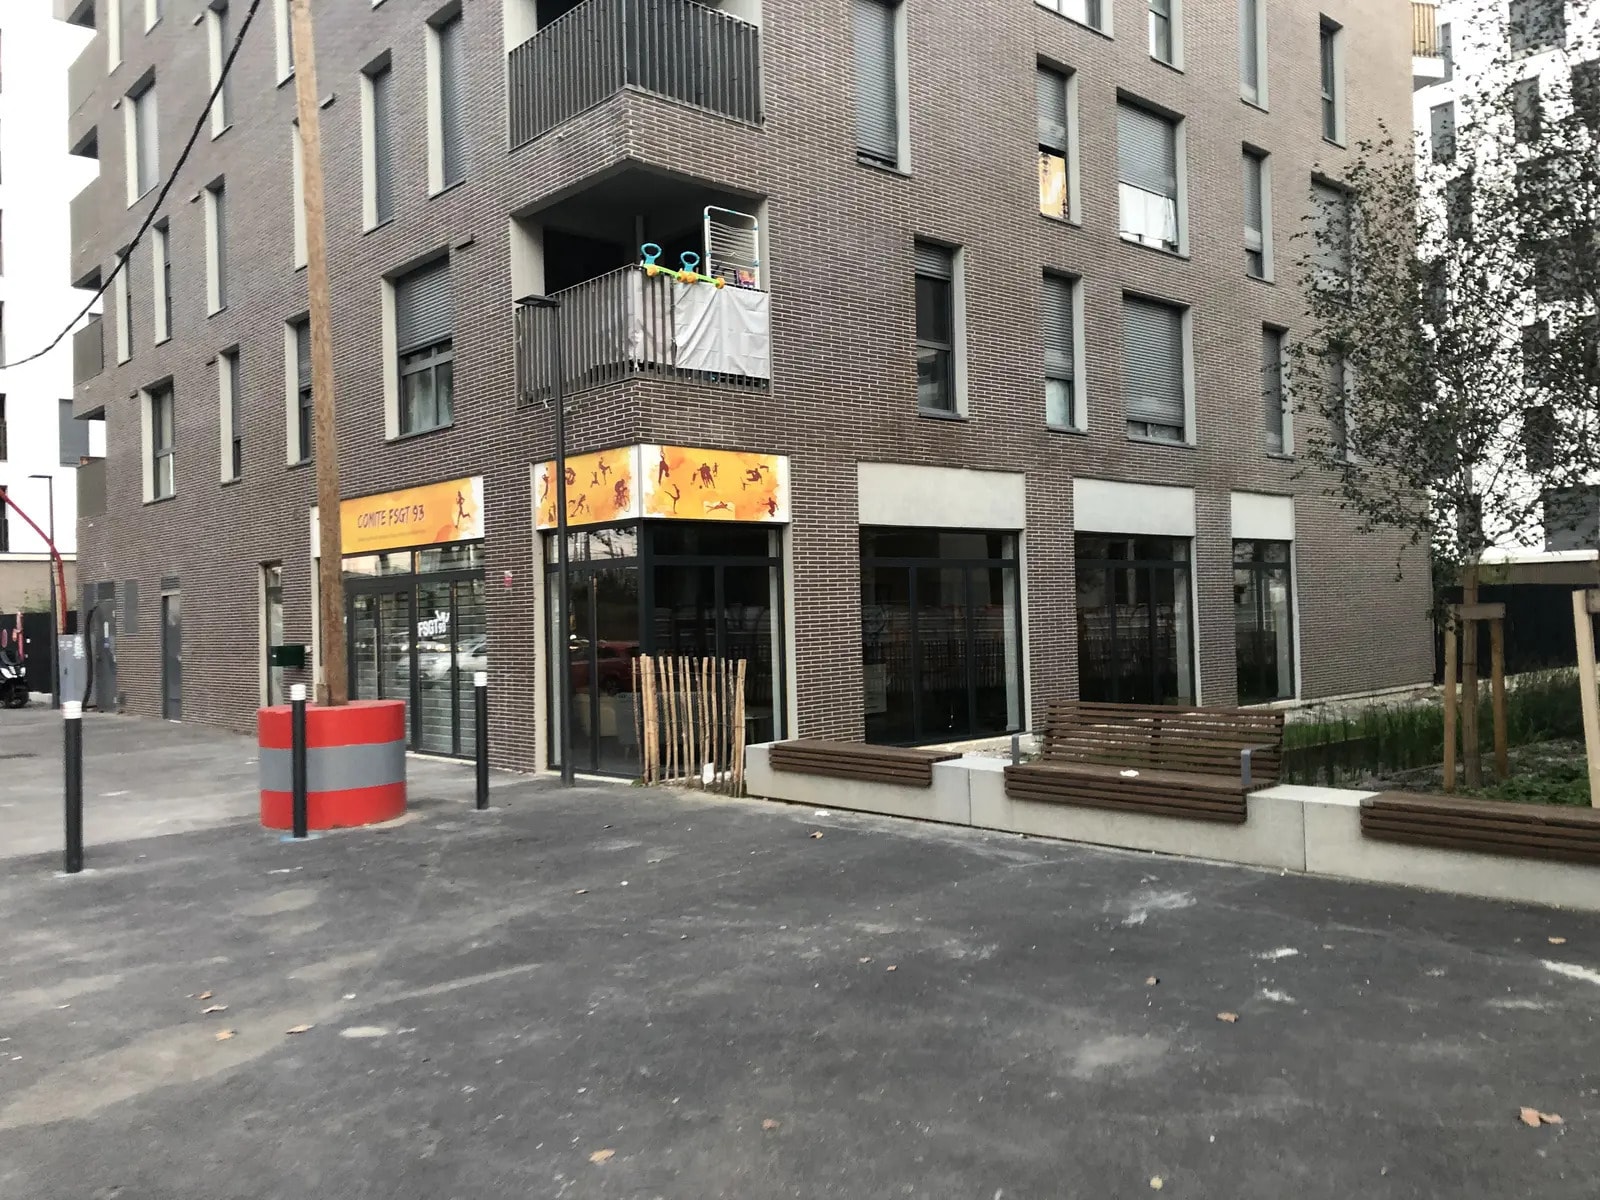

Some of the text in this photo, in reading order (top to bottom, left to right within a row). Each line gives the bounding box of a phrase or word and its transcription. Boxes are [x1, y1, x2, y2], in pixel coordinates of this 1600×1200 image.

[358, 504, 425, 528] COMITE FSGT 93
[417, 619, 438, 637] FSGT
